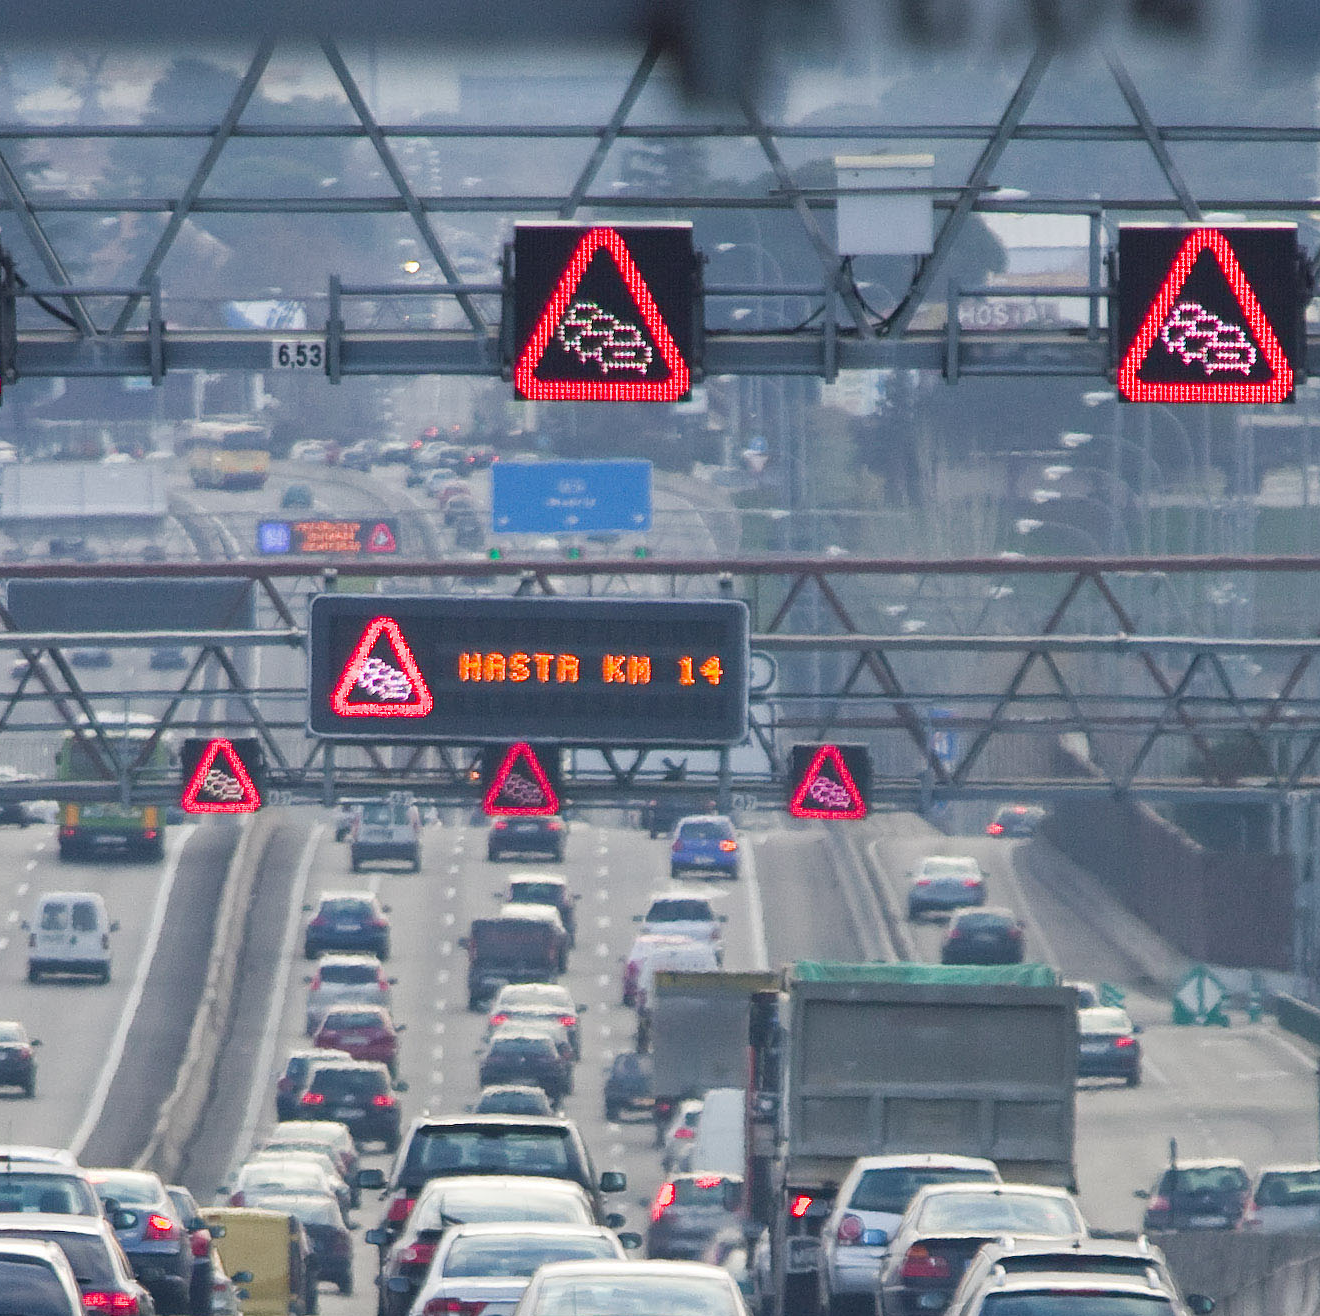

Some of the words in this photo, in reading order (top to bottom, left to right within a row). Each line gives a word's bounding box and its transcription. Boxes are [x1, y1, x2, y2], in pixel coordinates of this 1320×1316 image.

[278, 344, 322, 369] 6,53
[458, 652, 580, 684] HASTA
[678, 655, 724, 687] 14
